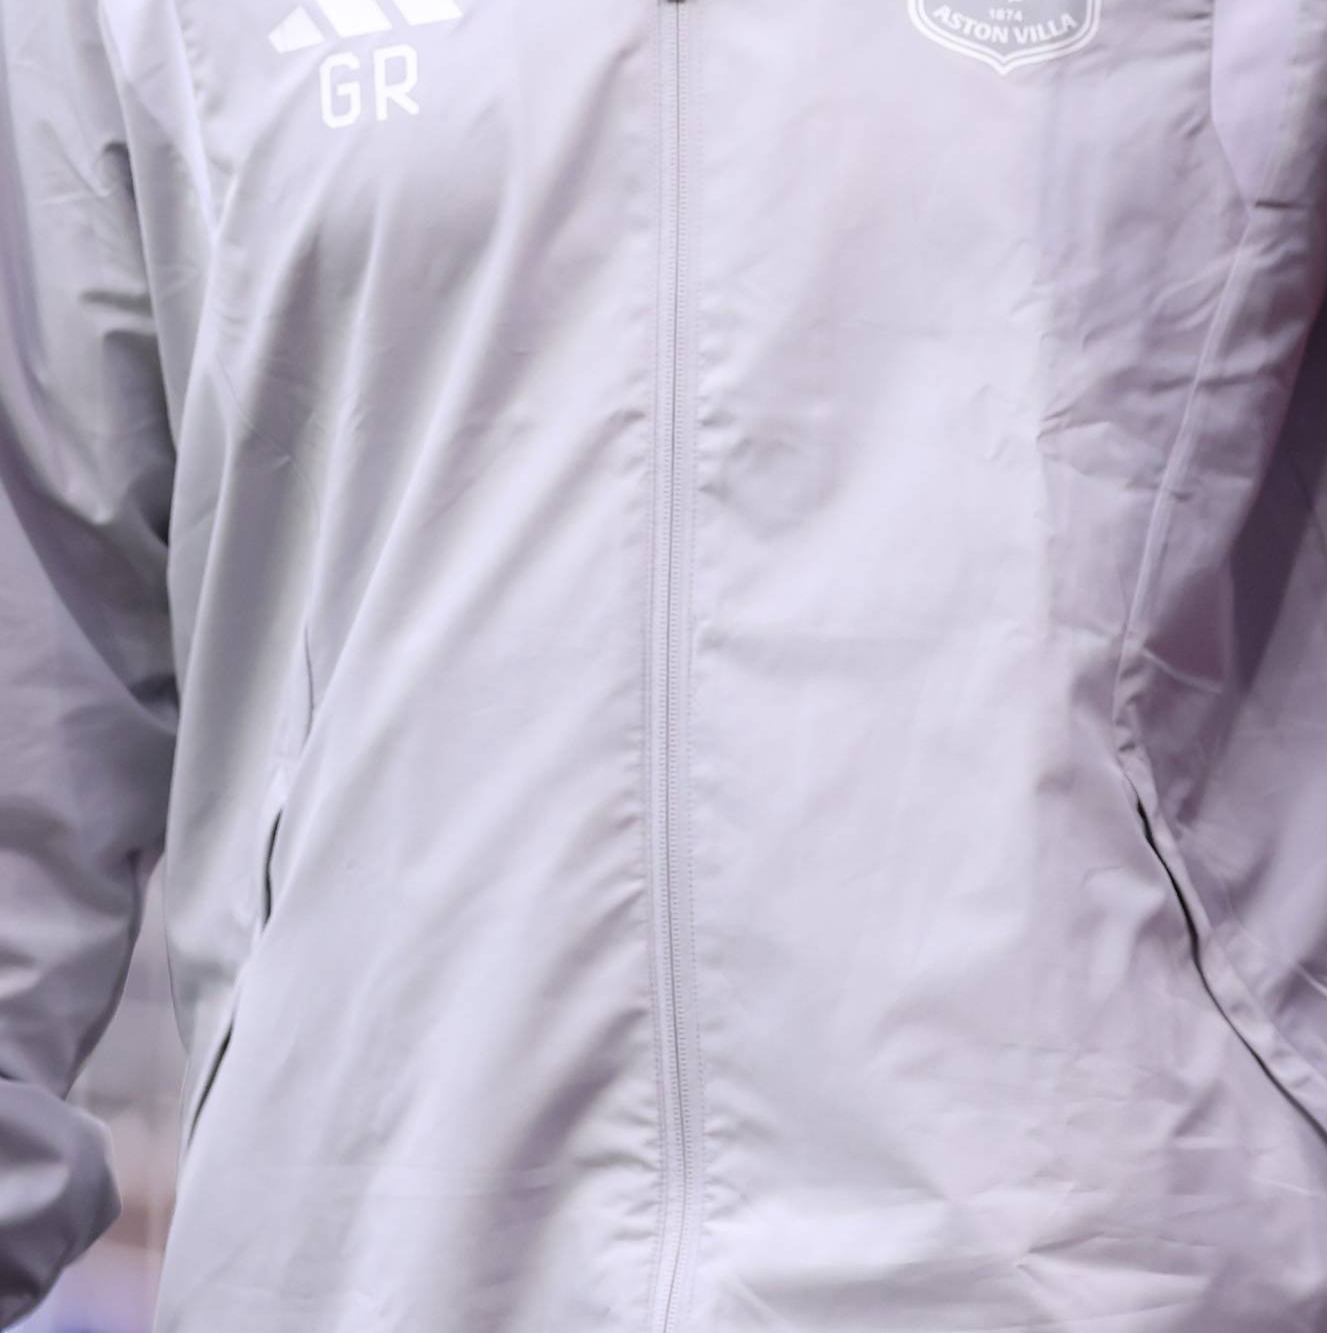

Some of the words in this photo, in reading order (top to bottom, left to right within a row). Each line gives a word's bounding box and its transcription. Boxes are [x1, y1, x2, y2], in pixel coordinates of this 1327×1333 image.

[932, 4, 1009, 43] ASTON
[1013, 13, 1077, 43] VILLA
[320, 44, 420, 128] GR
